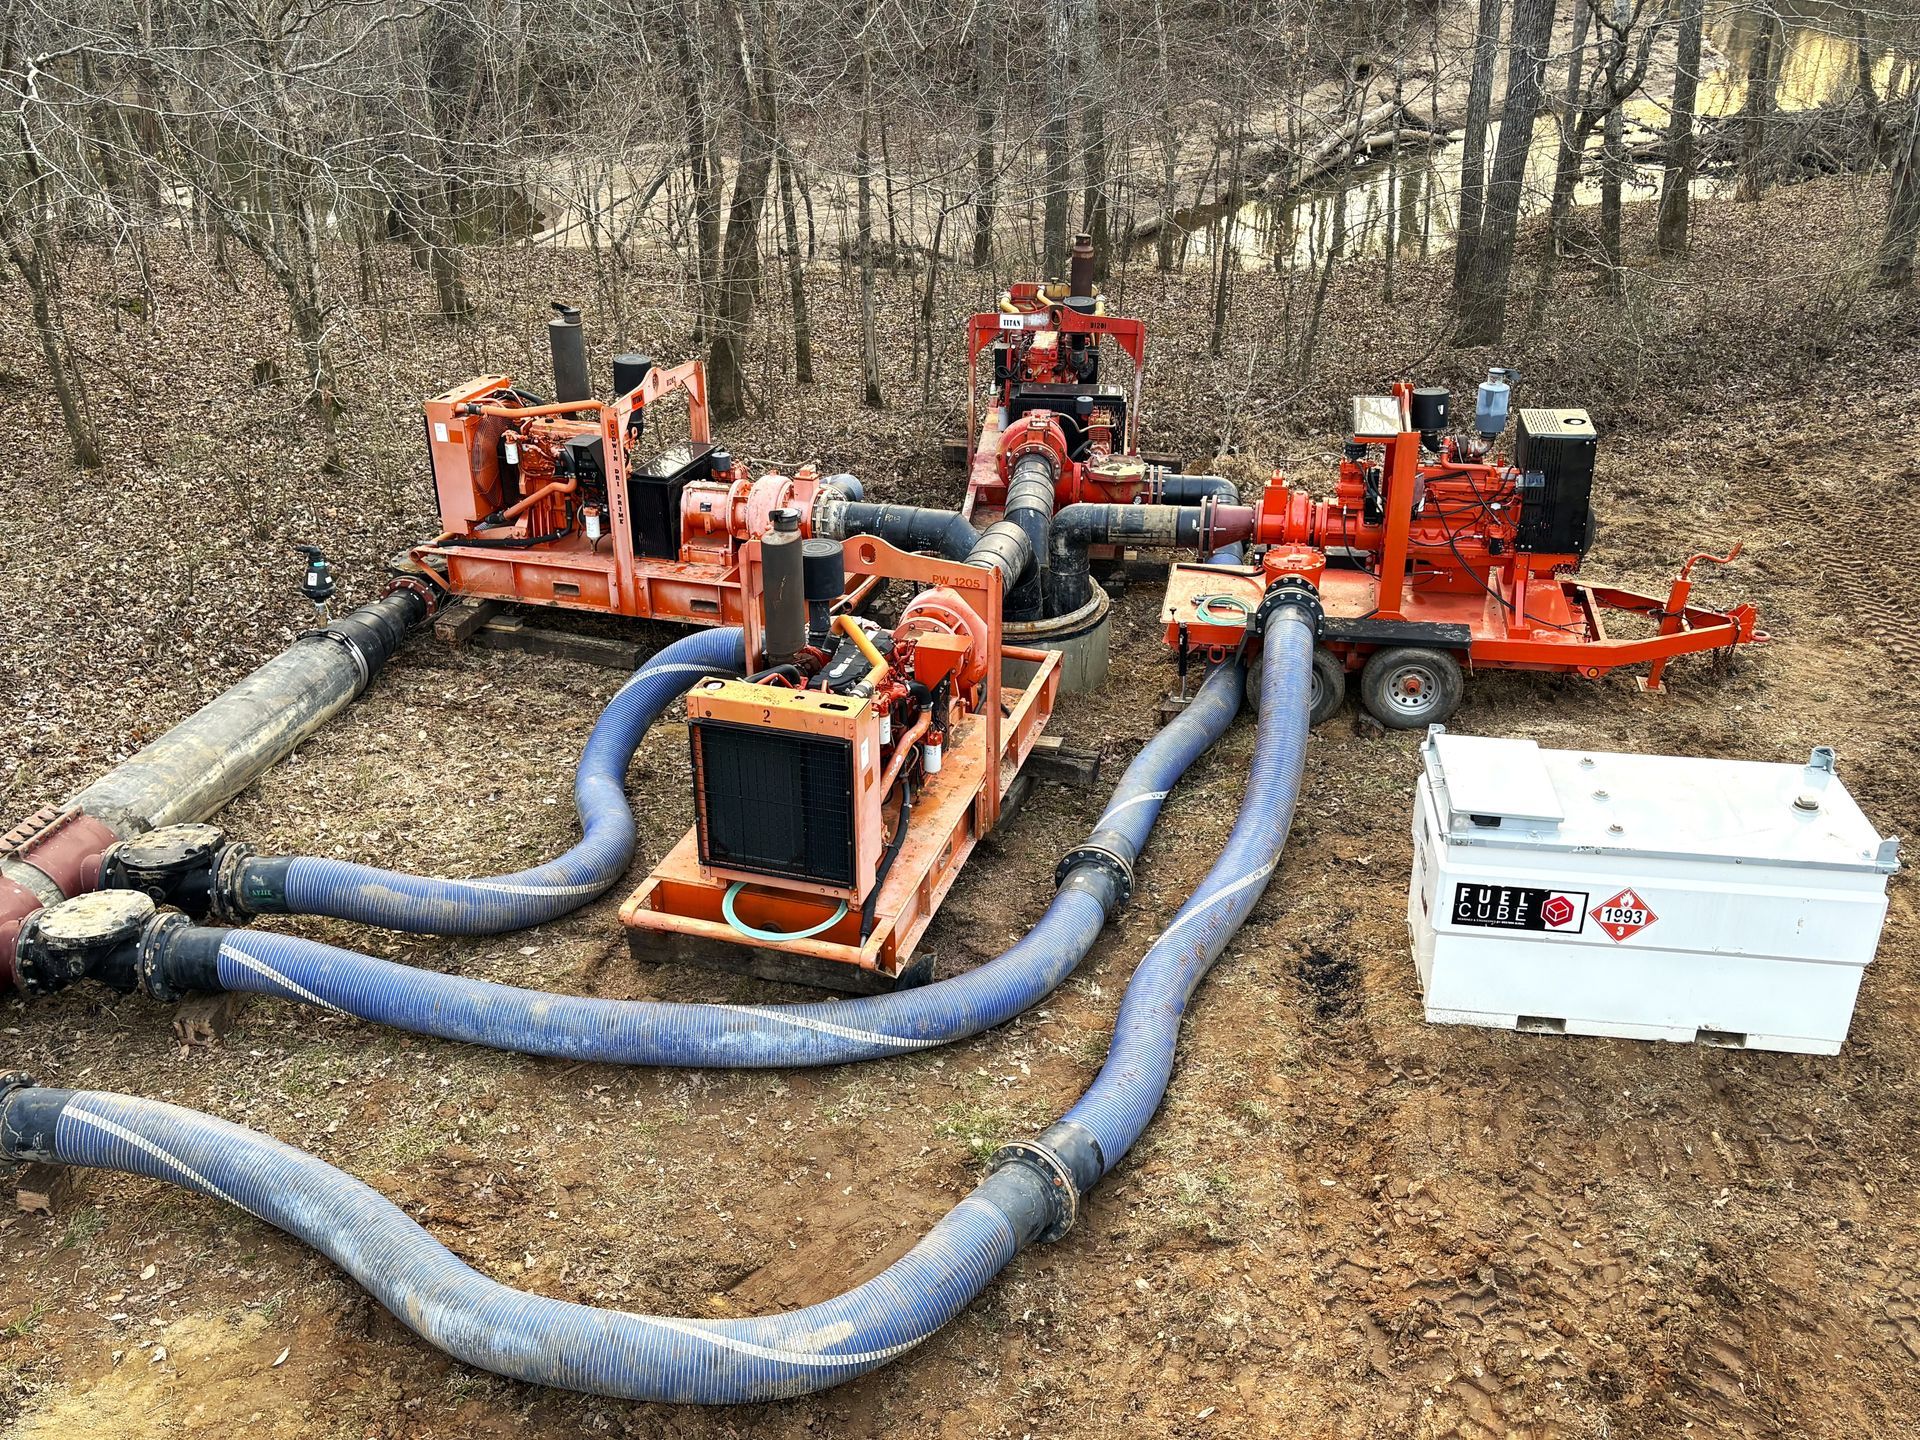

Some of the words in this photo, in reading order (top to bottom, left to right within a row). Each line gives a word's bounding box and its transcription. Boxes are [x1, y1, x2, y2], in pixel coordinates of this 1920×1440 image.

[1003, 319, 1020, 327] TITAN
[609, 424, 618, 461] GODWIN
[932, 575, 949, 584] PW
[955, 578, 980, 588] 1205
[763, 709, 771, 723] 2
[1460, 888, 1528, 907] FUEL
[1458, 903, 1528, 921] CUBE
[1605, 908, 1643, 924] 1993
[1616, 926, 1625, 937] 3
